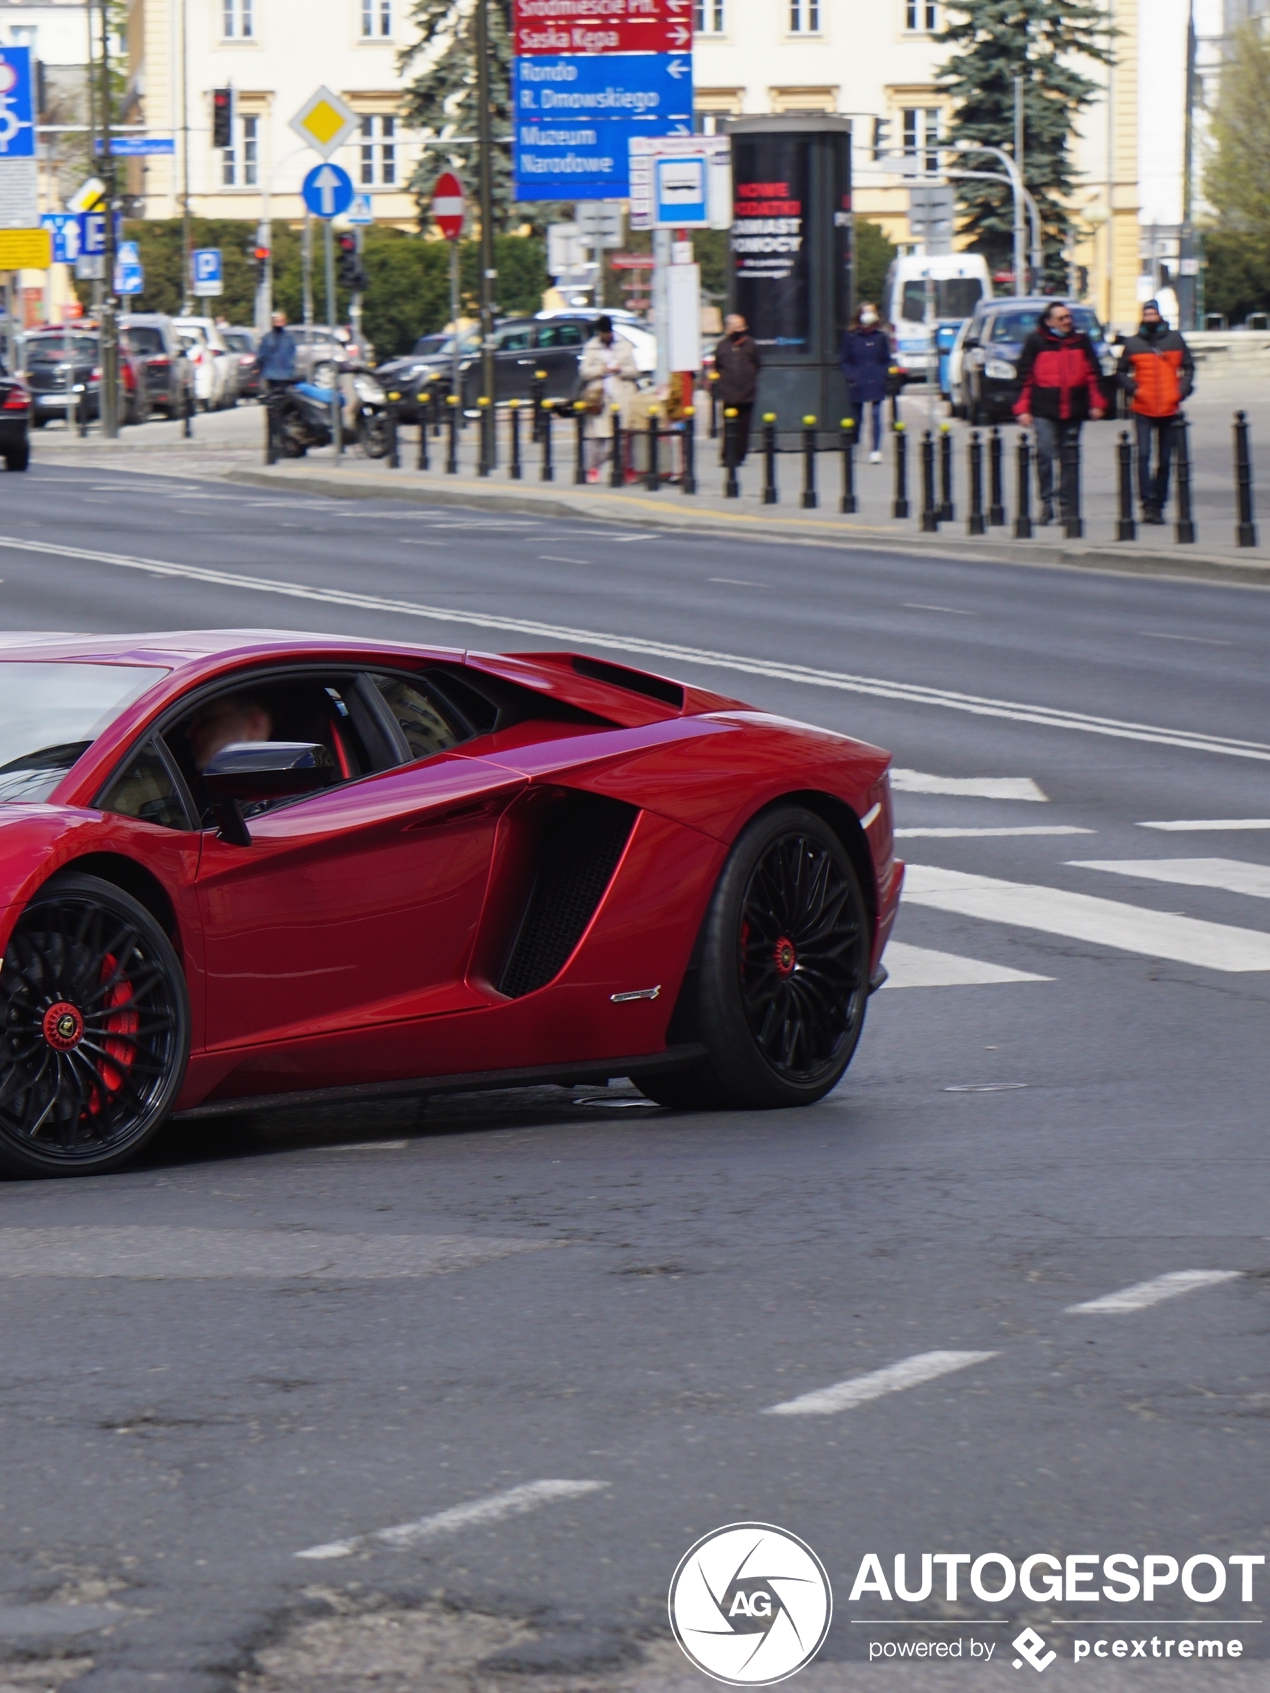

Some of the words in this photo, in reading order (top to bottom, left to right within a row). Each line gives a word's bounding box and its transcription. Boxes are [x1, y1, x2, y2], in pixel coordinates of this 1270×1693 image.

[519, 28, 570, 48] Saska
[571, 28, 619, 52] Kępa
[520, 61, 578, 81] Rondo
[520, 89, 539, 109] R.
[541, 87, 660, 113] Dmowskiego
[520, 126, 597, 146] Muzeum
[520, 152, 614, 173] Narodowe
